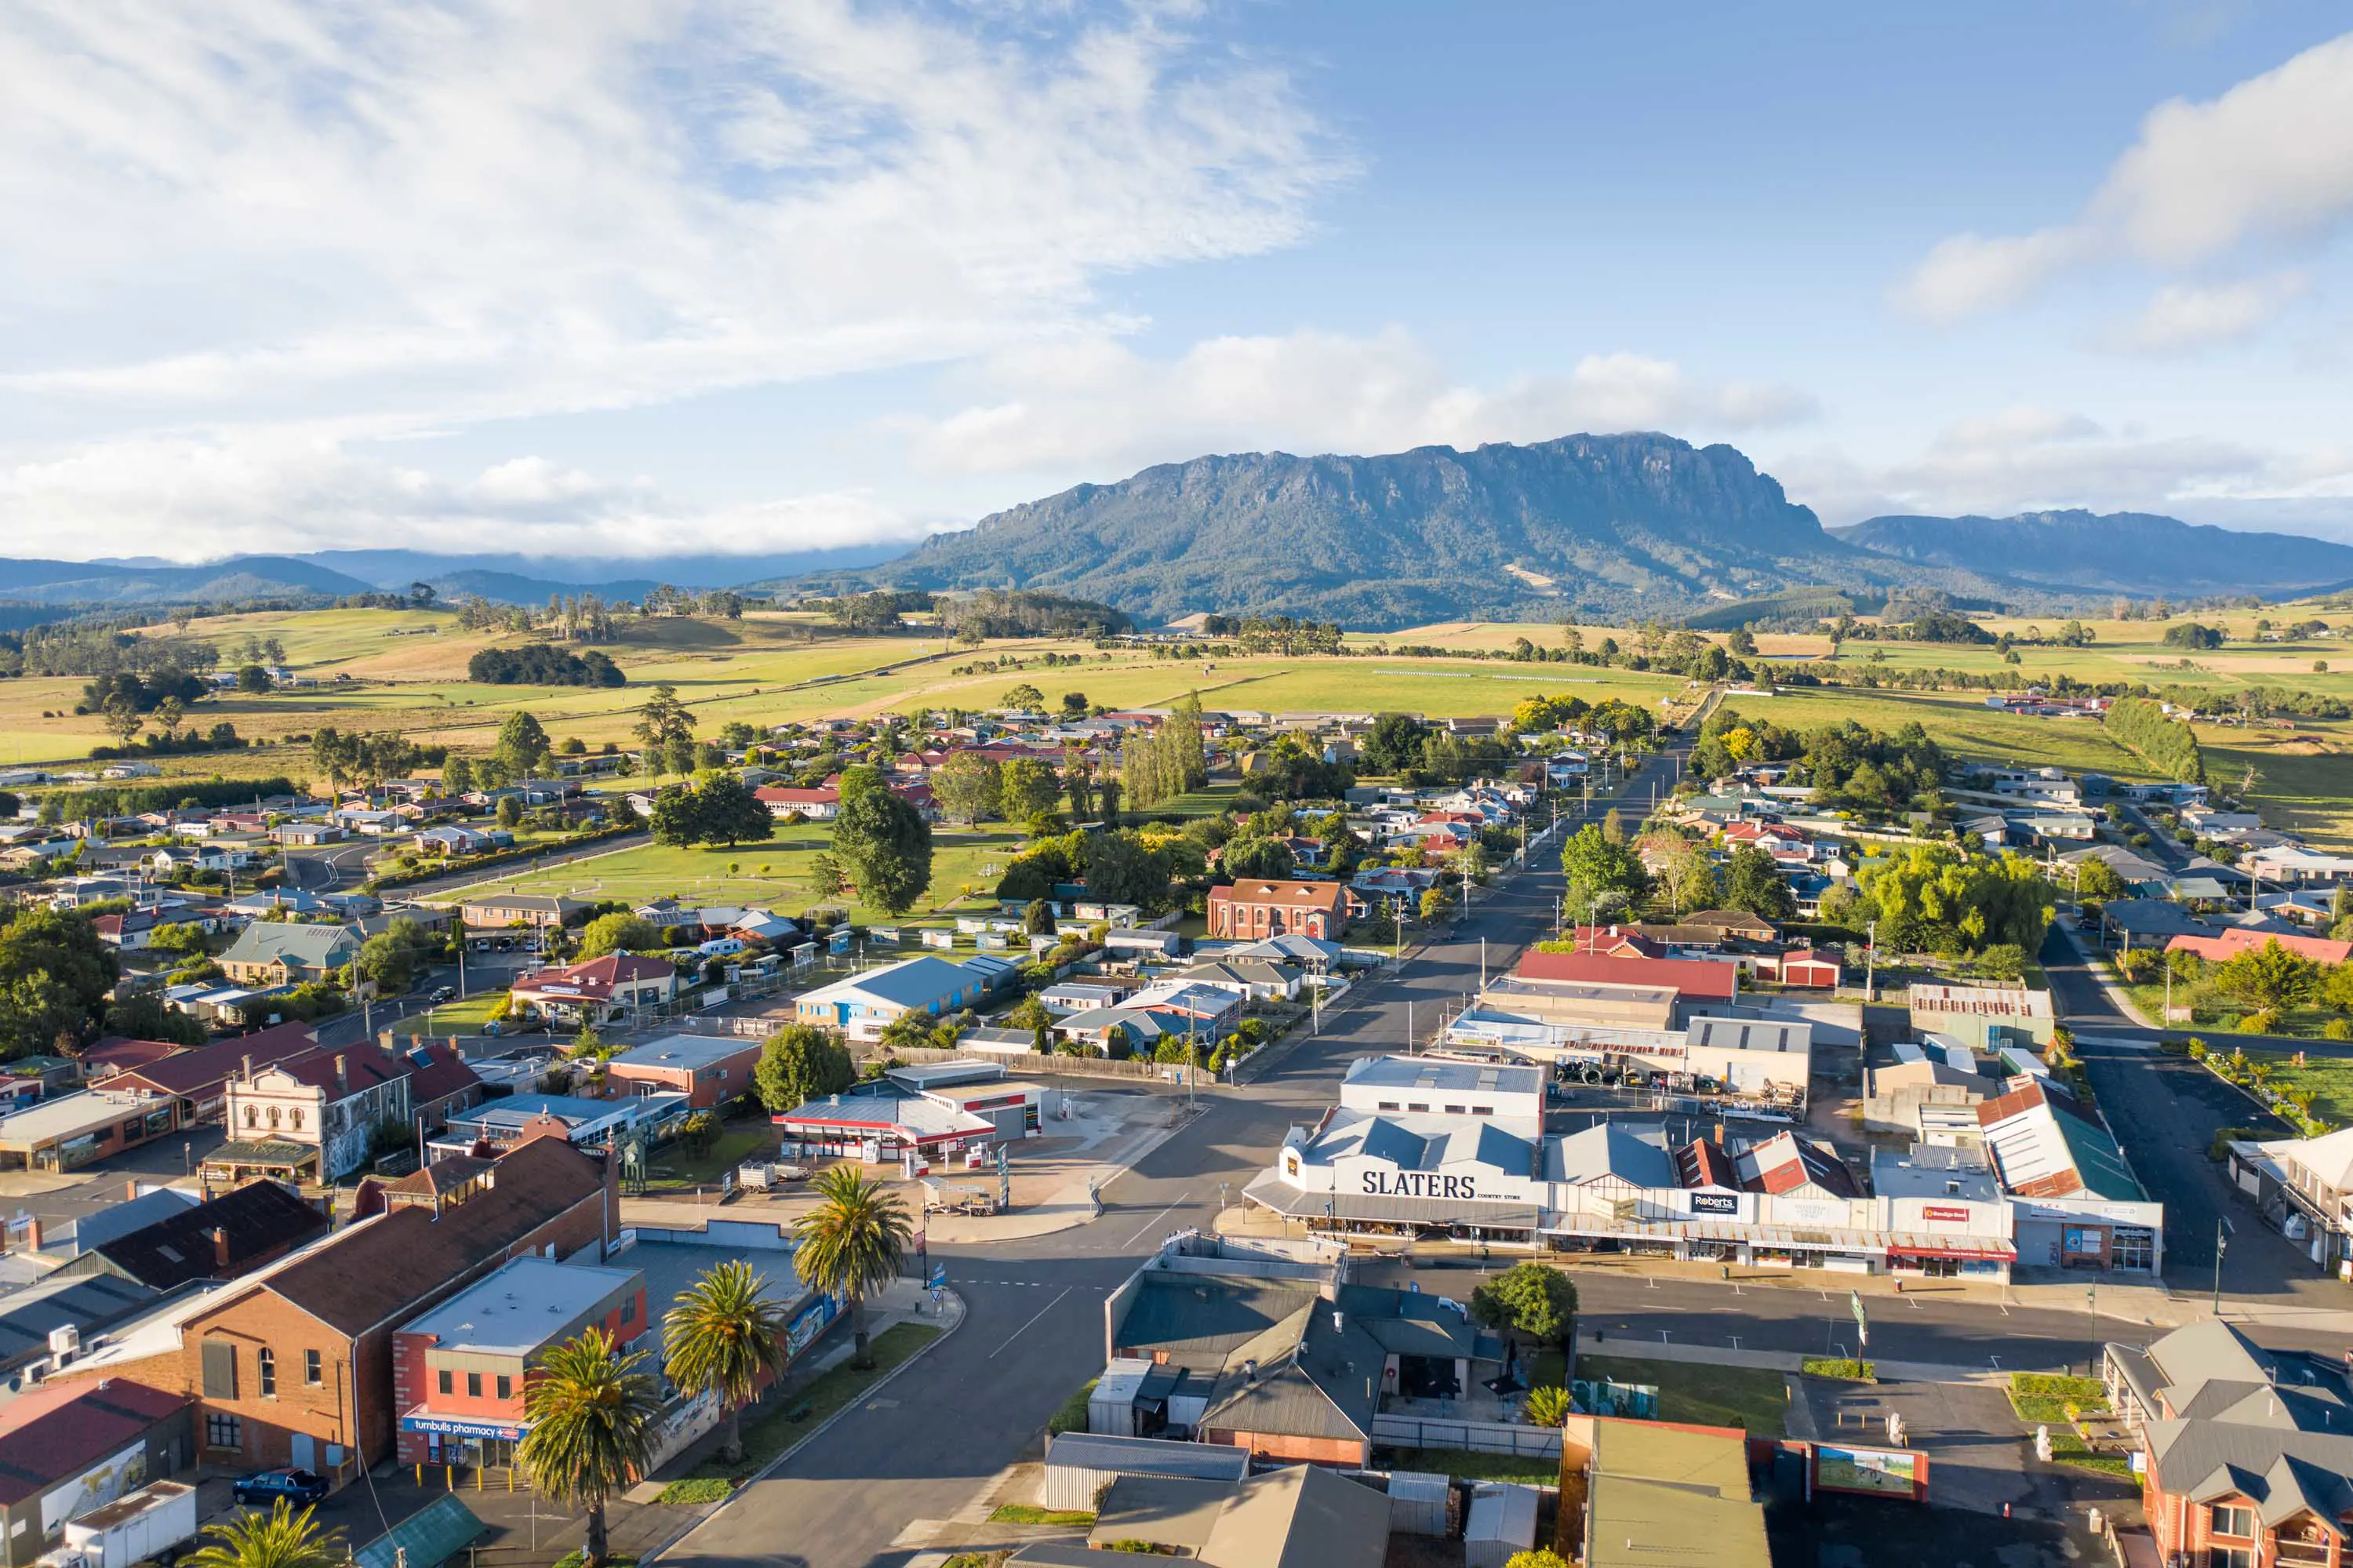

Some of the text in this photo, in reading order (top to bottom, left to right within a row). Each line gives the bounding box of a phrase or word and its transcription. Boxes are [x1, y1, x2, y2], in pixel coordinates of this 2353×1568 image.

[1362, 1171, 1475, 1199] SLATERS
[1695, 1196, 1733, 1206] Roberts
[415, 1421, 451, 1432] turnbulls
[453, 1424, 495, 1438] pharmacy
